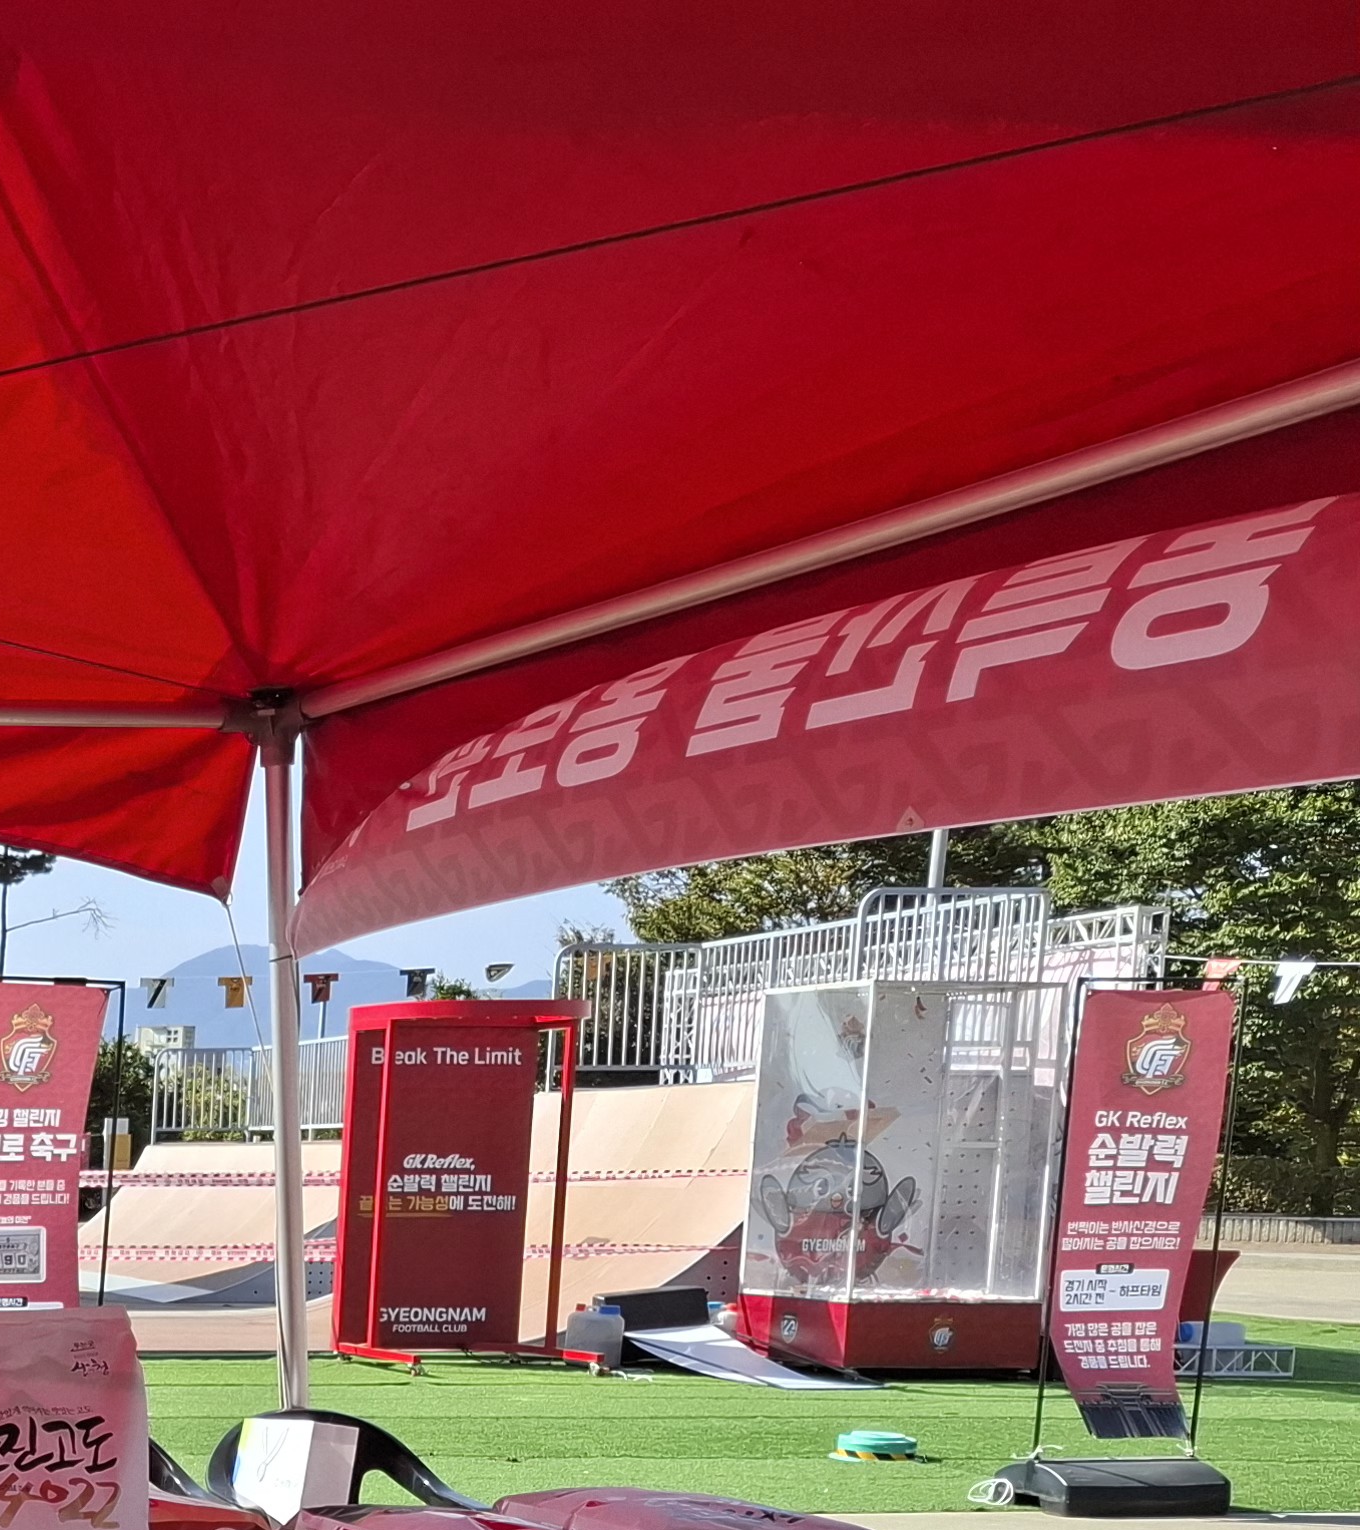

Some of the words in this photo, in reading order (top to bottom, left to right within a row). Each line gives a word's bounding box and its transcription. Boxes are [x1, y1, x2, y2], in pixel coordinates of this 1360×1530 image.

[371, 1047, 427, 1066] Beak
[433, 1047, 469, 1065] The
[474, 1047, 523, 1066] Limit
[13, 1108, 61, 1128] 챌린지
[1095, 1110, 1123, 1127] GK
[1126, 1111, 1188, 1129] Reflex
[30, 1131, 77, 1163] 축구
[1088, 1133, 1189, 1168] 순발력
[387, 1173, 437, 1193] 순발력
[440, 1174, 493, 1192] 챌린지
[1083, 1170, 1180, 1205] 챌린지
[31, 1194, 70, 1205] 드립니다!
[407, 1195, 464, 1211] 가능성에
[467, 1195, 517, 1211] 도전해!
[1111, 1220, 1181, 1234] 반사신경으로
[1061, 1237, 1104, 1250] 떨어지는
[1129, 1237, 1181, 1250] 잡으세요!
[1064, 1279, 1085, 1291] 경기
[1086, 1278, 1108, 1291] 시작
[1118, 1284, 1163, 1297] 하프타임
[1064, 1293, 1093, 1305] 2시간
[1094, 1293, 1105, 1305] 전
[392, 1324, 440, 1333] FOOTBALL
[442, 1324, 468, 1333] CLUB
[1063, 1323, 1086, 1336] 가장
